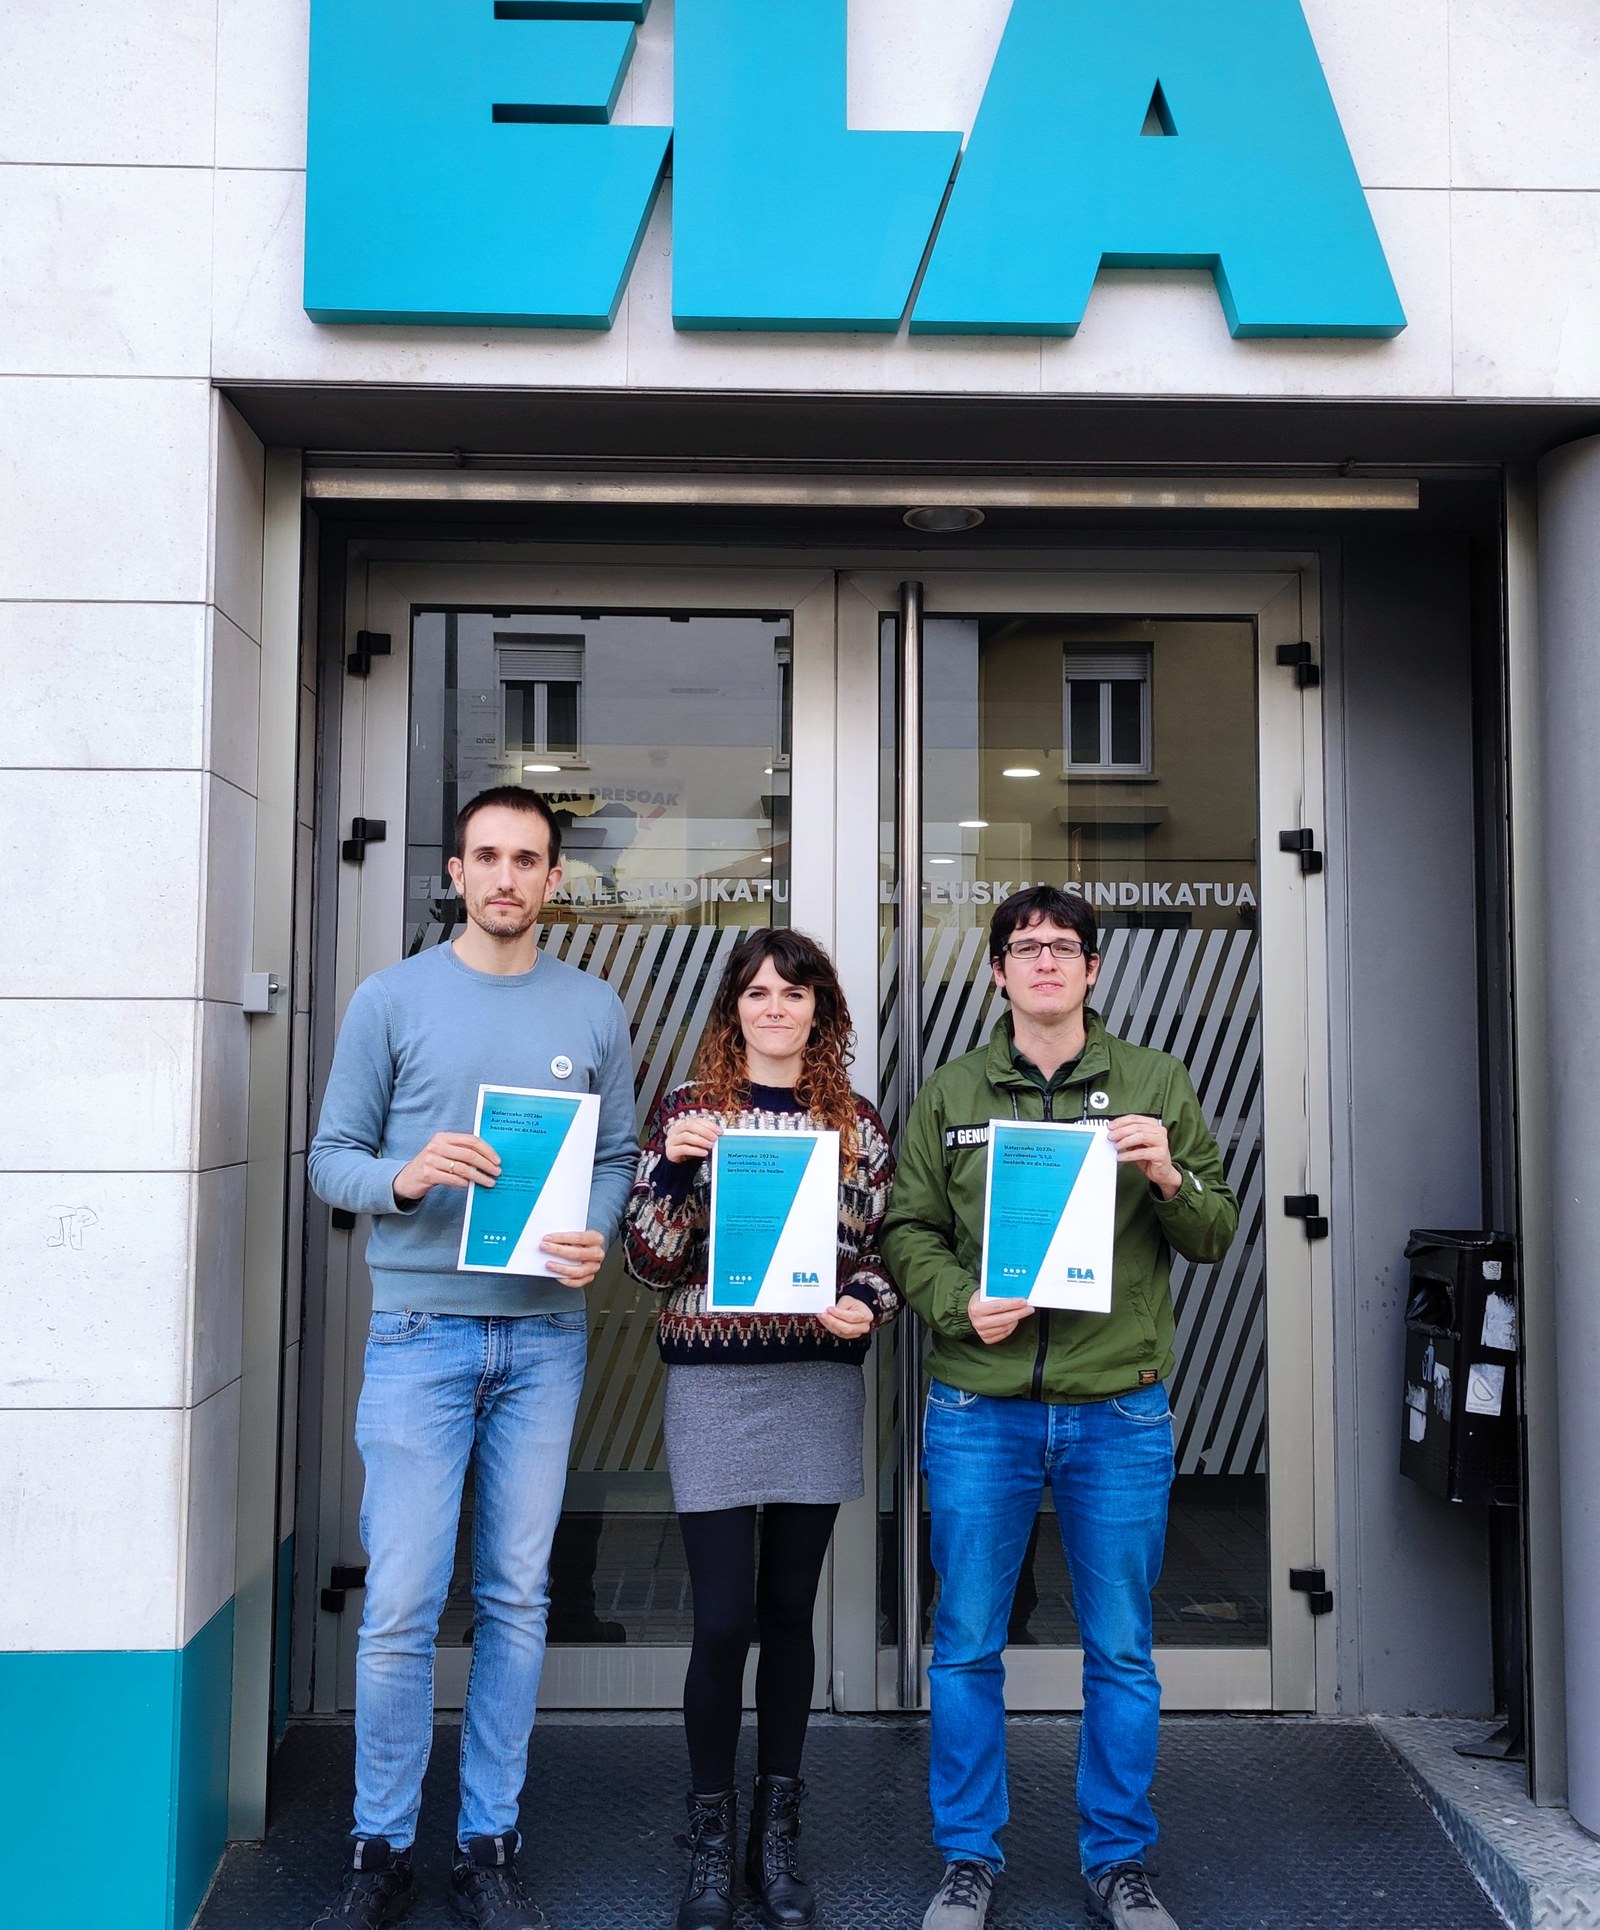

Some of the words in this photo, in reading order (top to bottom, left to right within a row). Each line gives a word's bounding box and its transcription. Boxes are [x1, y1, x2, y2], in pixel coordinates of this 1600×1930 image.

[304, 0, 1410, 339] ELA
[542, 788, 582, 804] KAL
[589, 787, 680, 806] PRESOAK
[549, 877, 612, 901] KAL
[930, 880, 1045, 905] EUSK
[1063, 881, 1258, 907] SINDIKATUA
[792, 1271, 820, 1283] ELA
[1067, 1267, 1095, 1280] ELA
